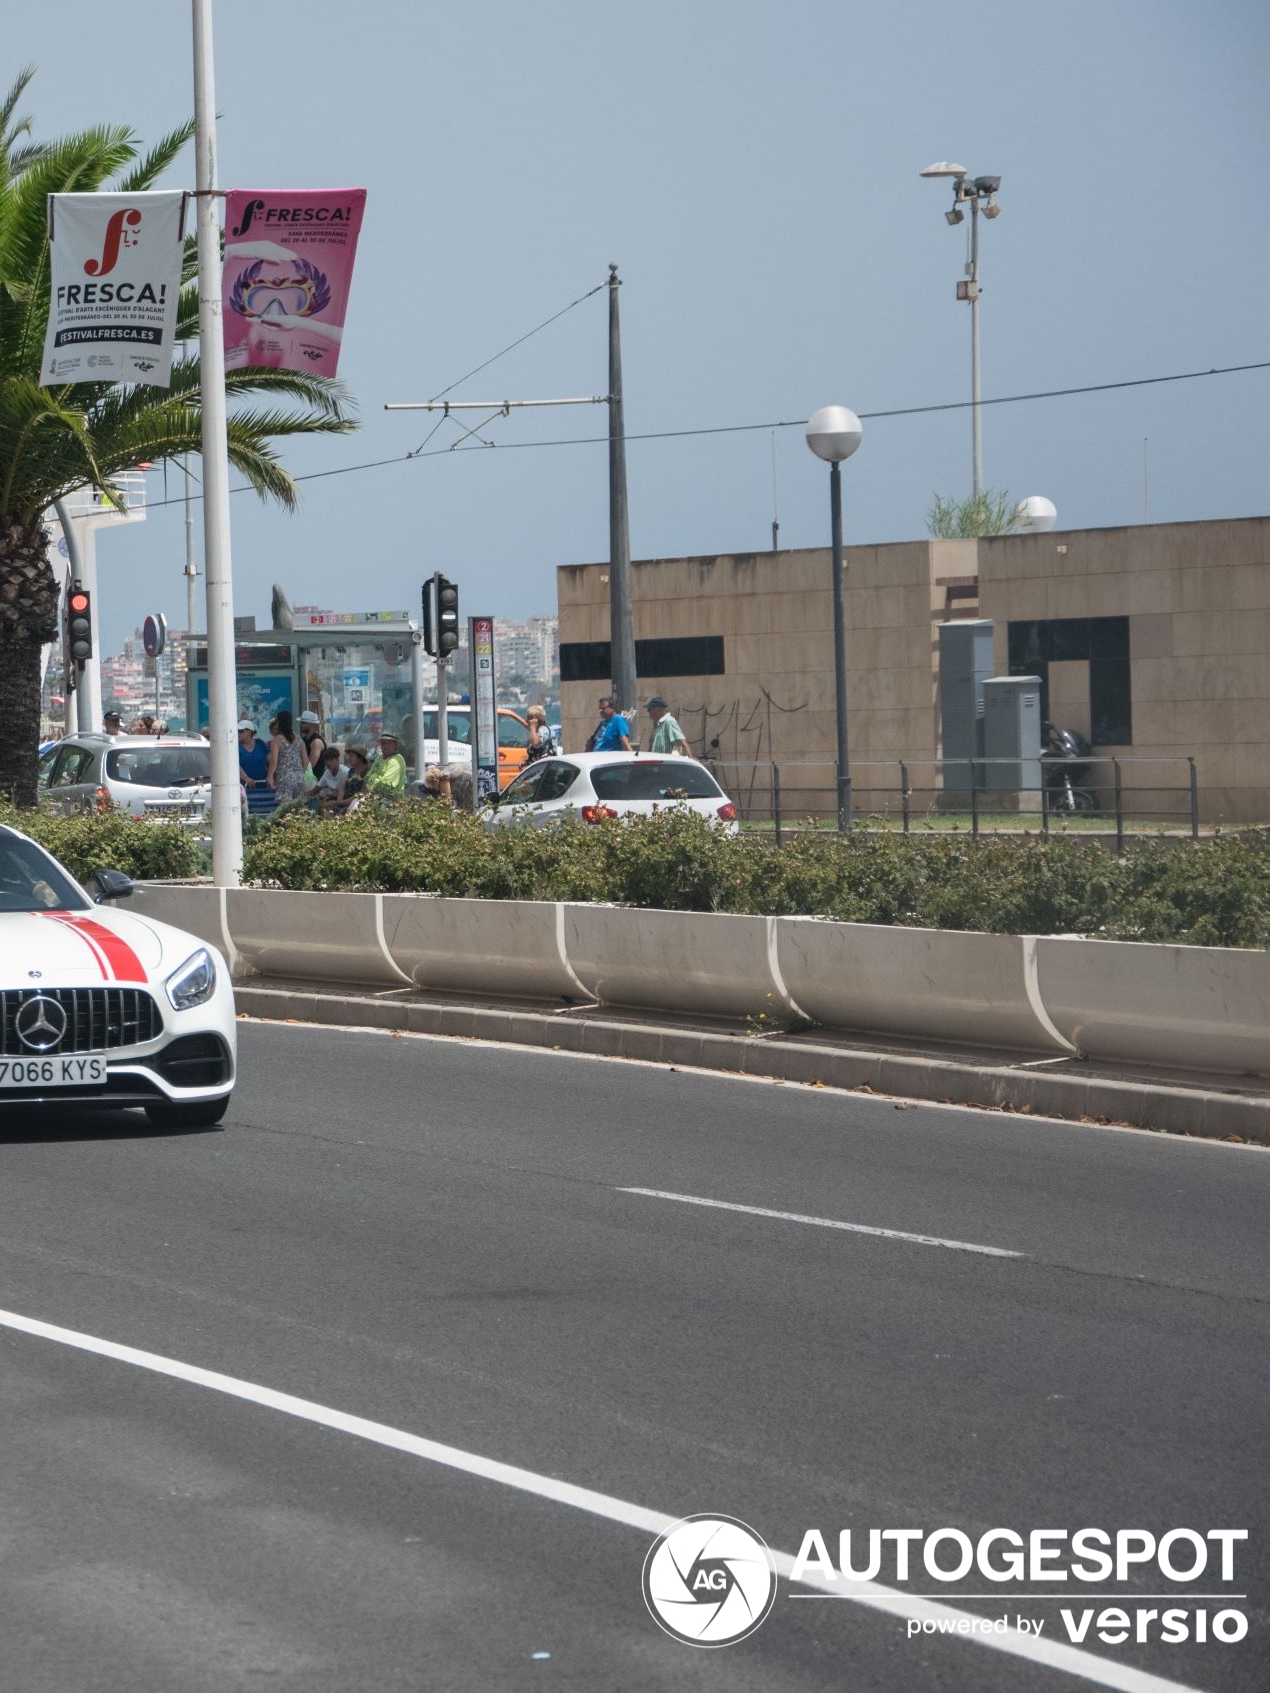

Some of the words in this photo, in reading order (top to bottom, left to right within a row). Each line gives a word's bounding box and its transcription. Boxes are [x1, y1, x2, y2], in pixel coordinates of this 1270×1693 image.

[266, 207, 351, 222] FRESCA!
[57, 283, 166, 308] FRESCA!
[95, 304, 131, 312] ESCÈNIQUES
[133, 306, 165, 314] D'ALACANT
[60, 329, 154, 343] FESTIVALFRESCA.ES
[62, 1059, 101, 1081] KYS
